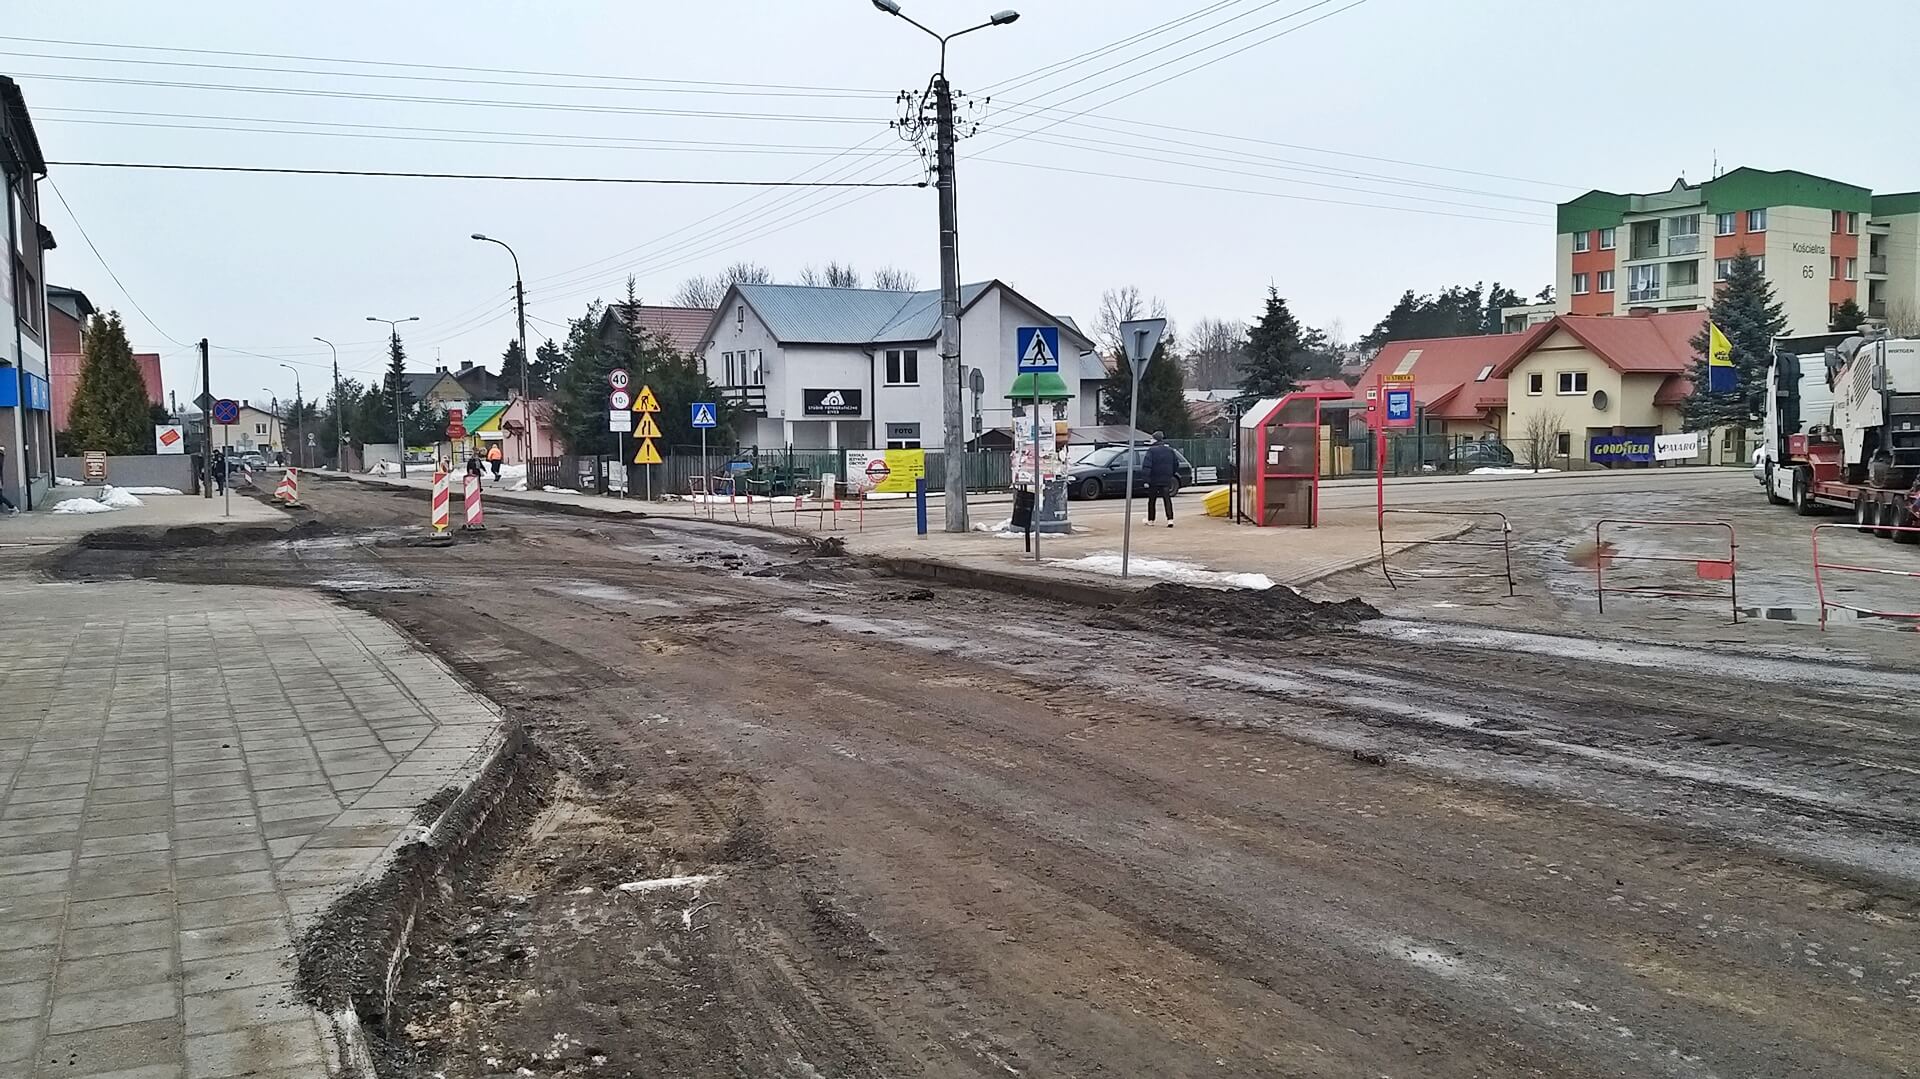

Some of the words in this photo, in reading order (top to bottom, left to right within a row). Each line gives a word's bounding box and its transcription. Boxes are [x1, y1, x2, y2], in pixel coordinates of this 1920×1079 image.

[1792, 242, 1825, 254] Kościelna
[1802, 265, 1814, 279] 65
[612, 374, 627, 385] 40
[1594, 441, 1649, 456] GOODYEAR
